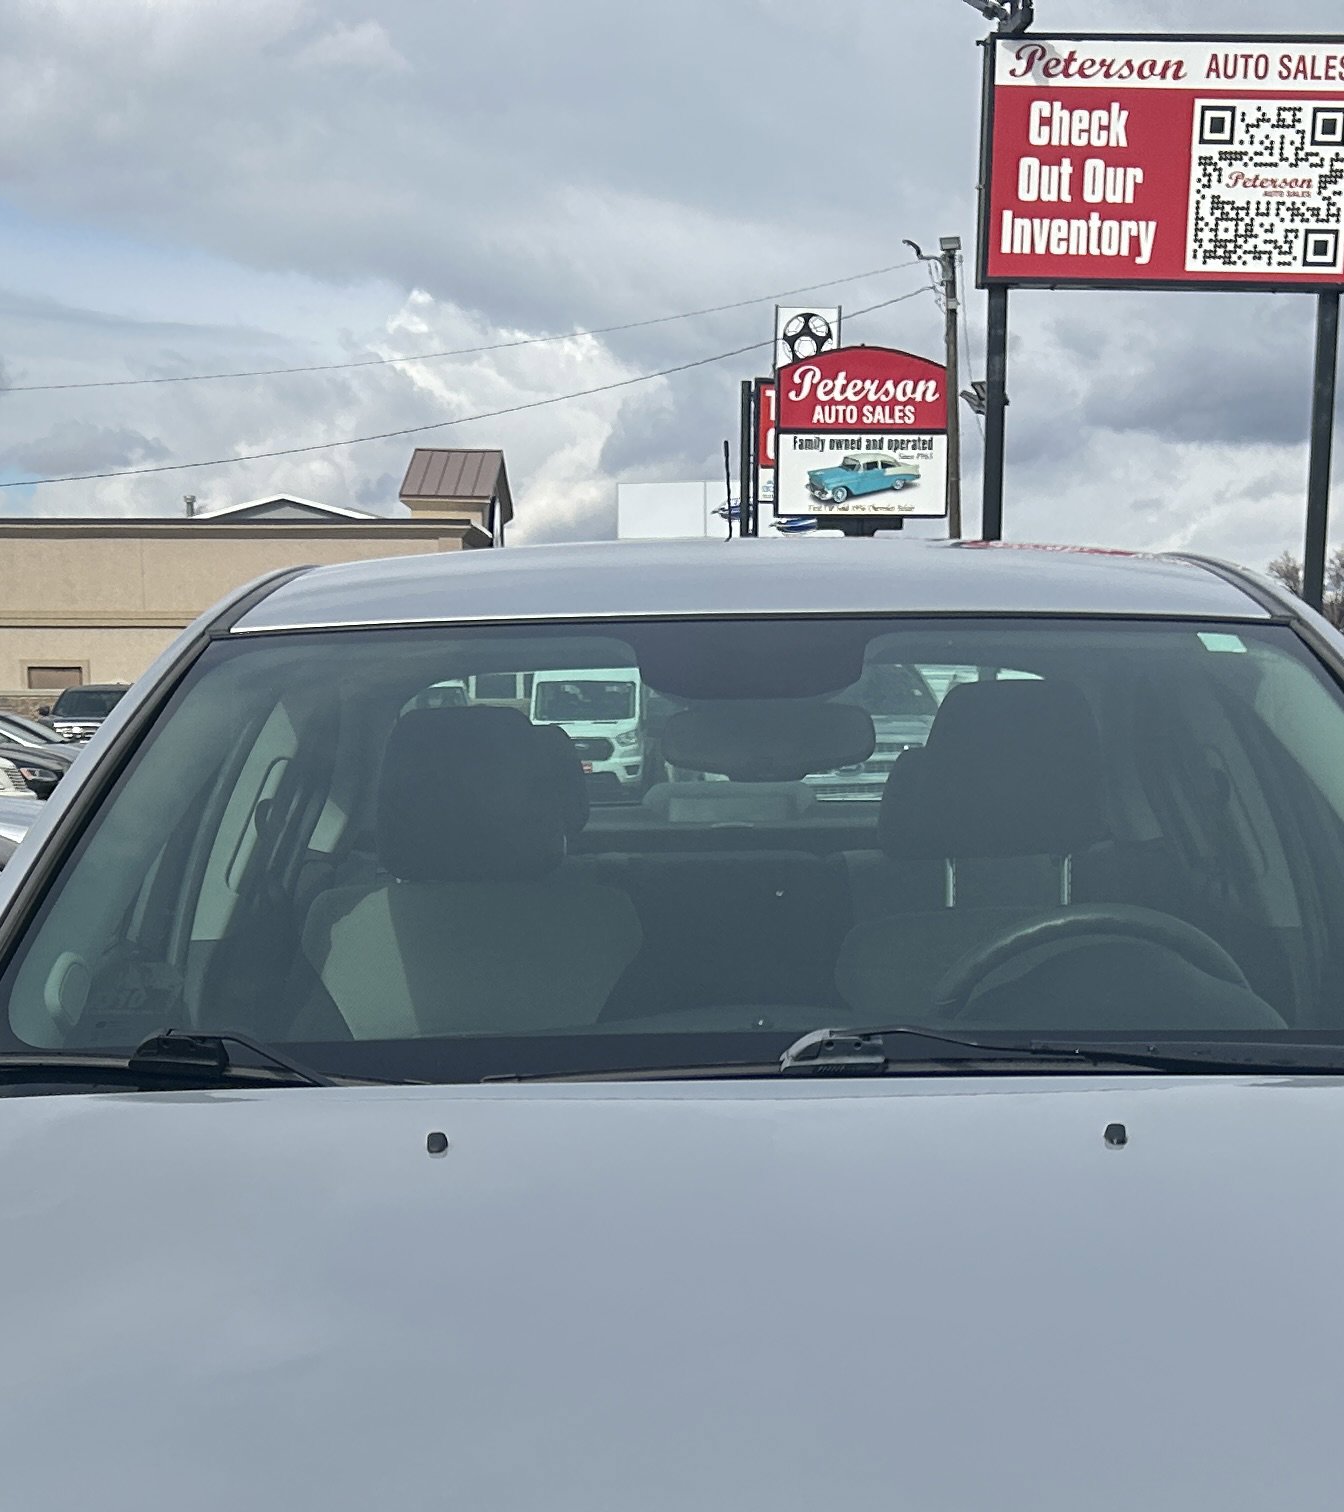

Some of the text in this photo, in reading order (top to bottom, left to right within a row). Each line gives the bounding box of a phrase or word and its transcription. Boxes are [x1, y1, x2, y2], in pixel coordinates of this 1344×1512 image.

[1009, 43, 1187, 81] Peterson
[1206, 53, 1269, 80] AUTO
[1029, 100, 1129, 147] Check
[1018, 157, 1143, 204] Out Our
[1225, 171, 1312, 188] Peterson
[1000, 210, 1156, 265] Inventory
[788, 366, 940, 402] Peterson
[812, 406, 915, 424] AUTO SALES
[793, 436, 933, 453] Family owned and operated
